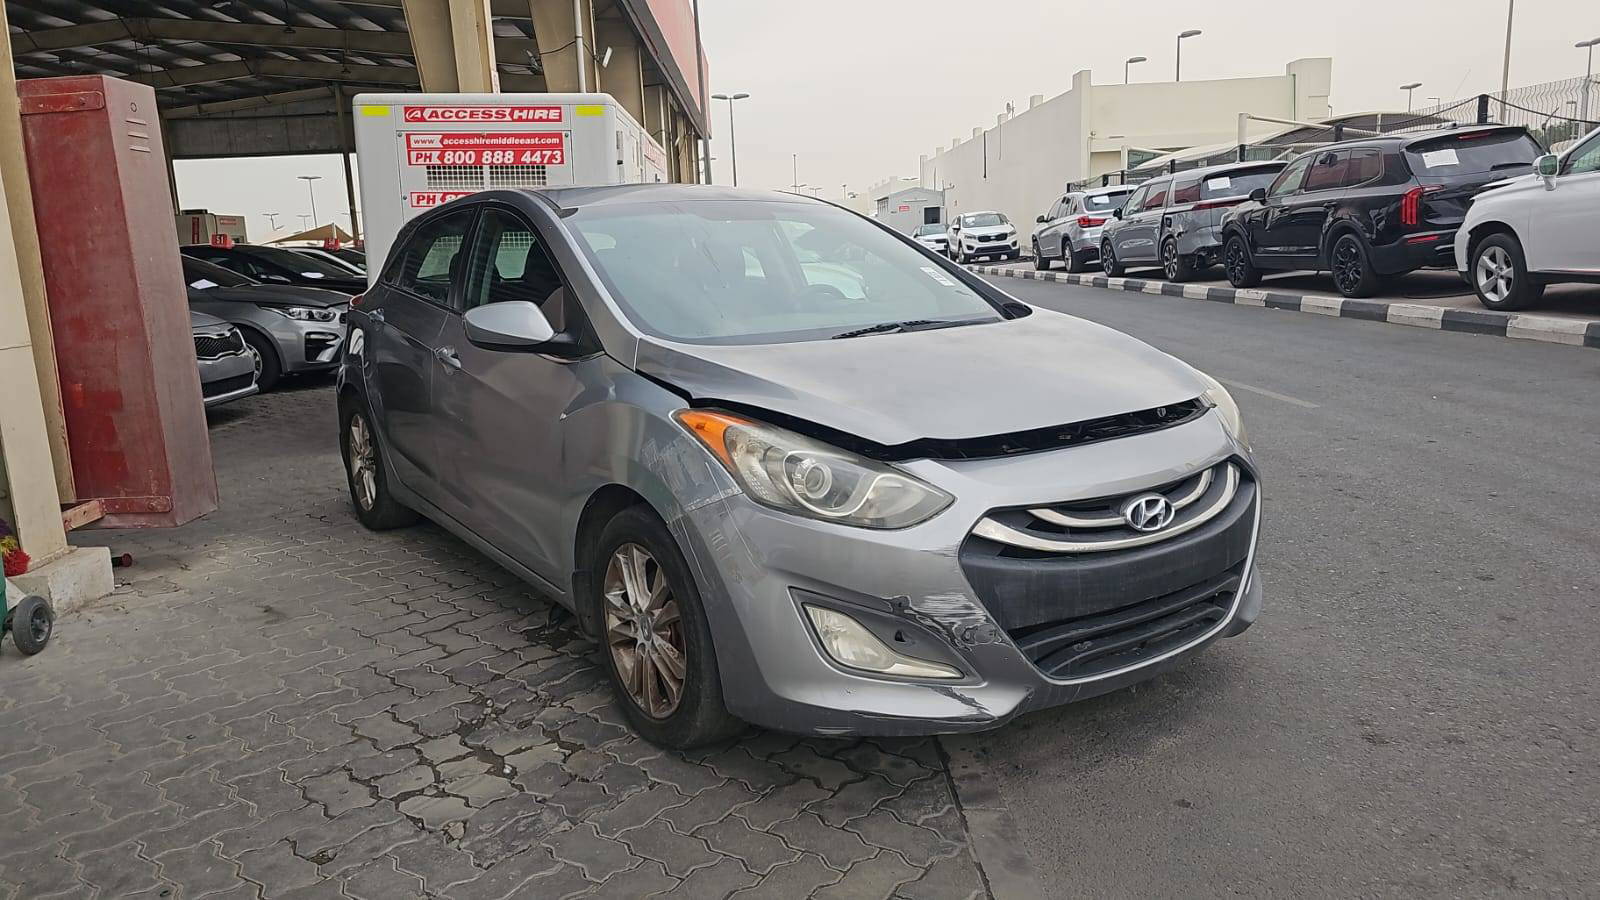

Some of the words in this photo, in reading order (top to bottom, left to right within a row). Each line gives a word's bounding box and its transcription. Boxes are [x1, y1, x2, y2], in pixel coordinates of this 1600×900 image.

[427, 109, 508, 120] ACCESS
[512, 109, 561, 120] HIRE
[442, 136, 560, 146] accesshiremiddleeast.com
[415, 152, 433, 163] PH
[443, 151, 476, 164] 800
[482, 151, 514, 164] 888
[520, 151, 562, 164] 4473
[416, 194, 436, 205] PH
